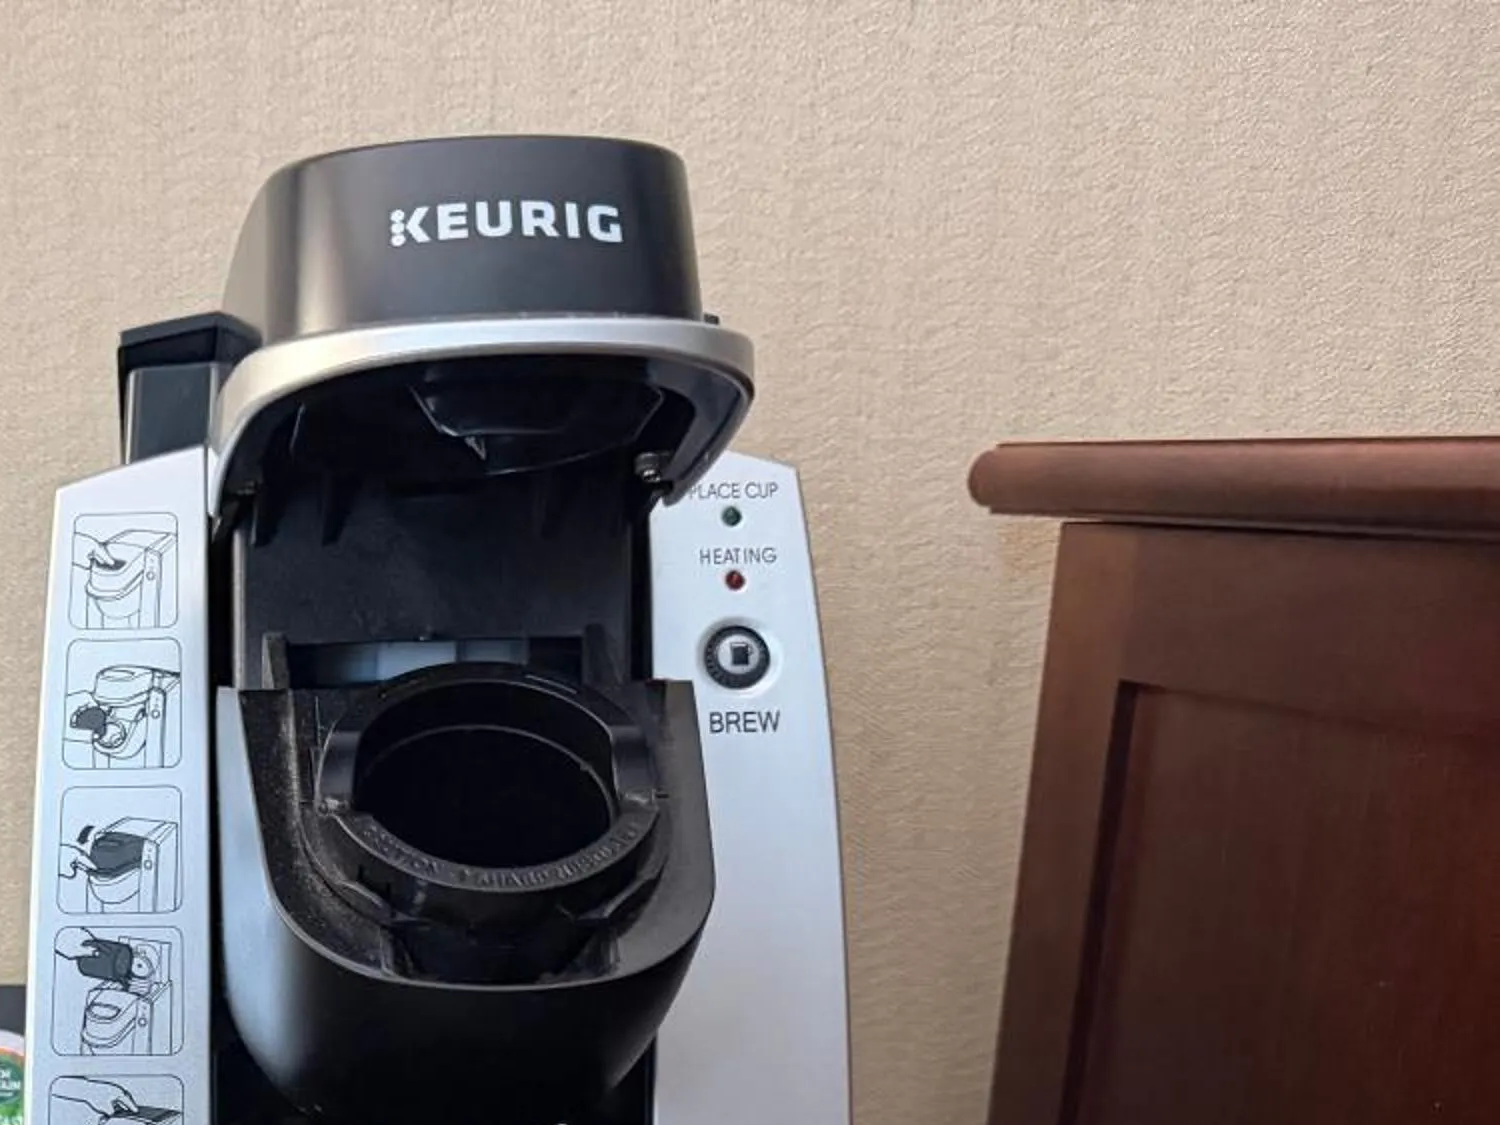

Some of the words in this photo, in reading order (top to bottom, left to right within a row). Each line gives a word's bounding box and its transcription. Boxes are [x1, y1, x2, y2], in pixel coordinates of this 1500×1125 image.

[390, 200, 623, 246] KEURIG
[744, 481, 779, 499] CUP
[699, 547, 777, 565] HEATING
[708, 711, 781, 734] BREW
